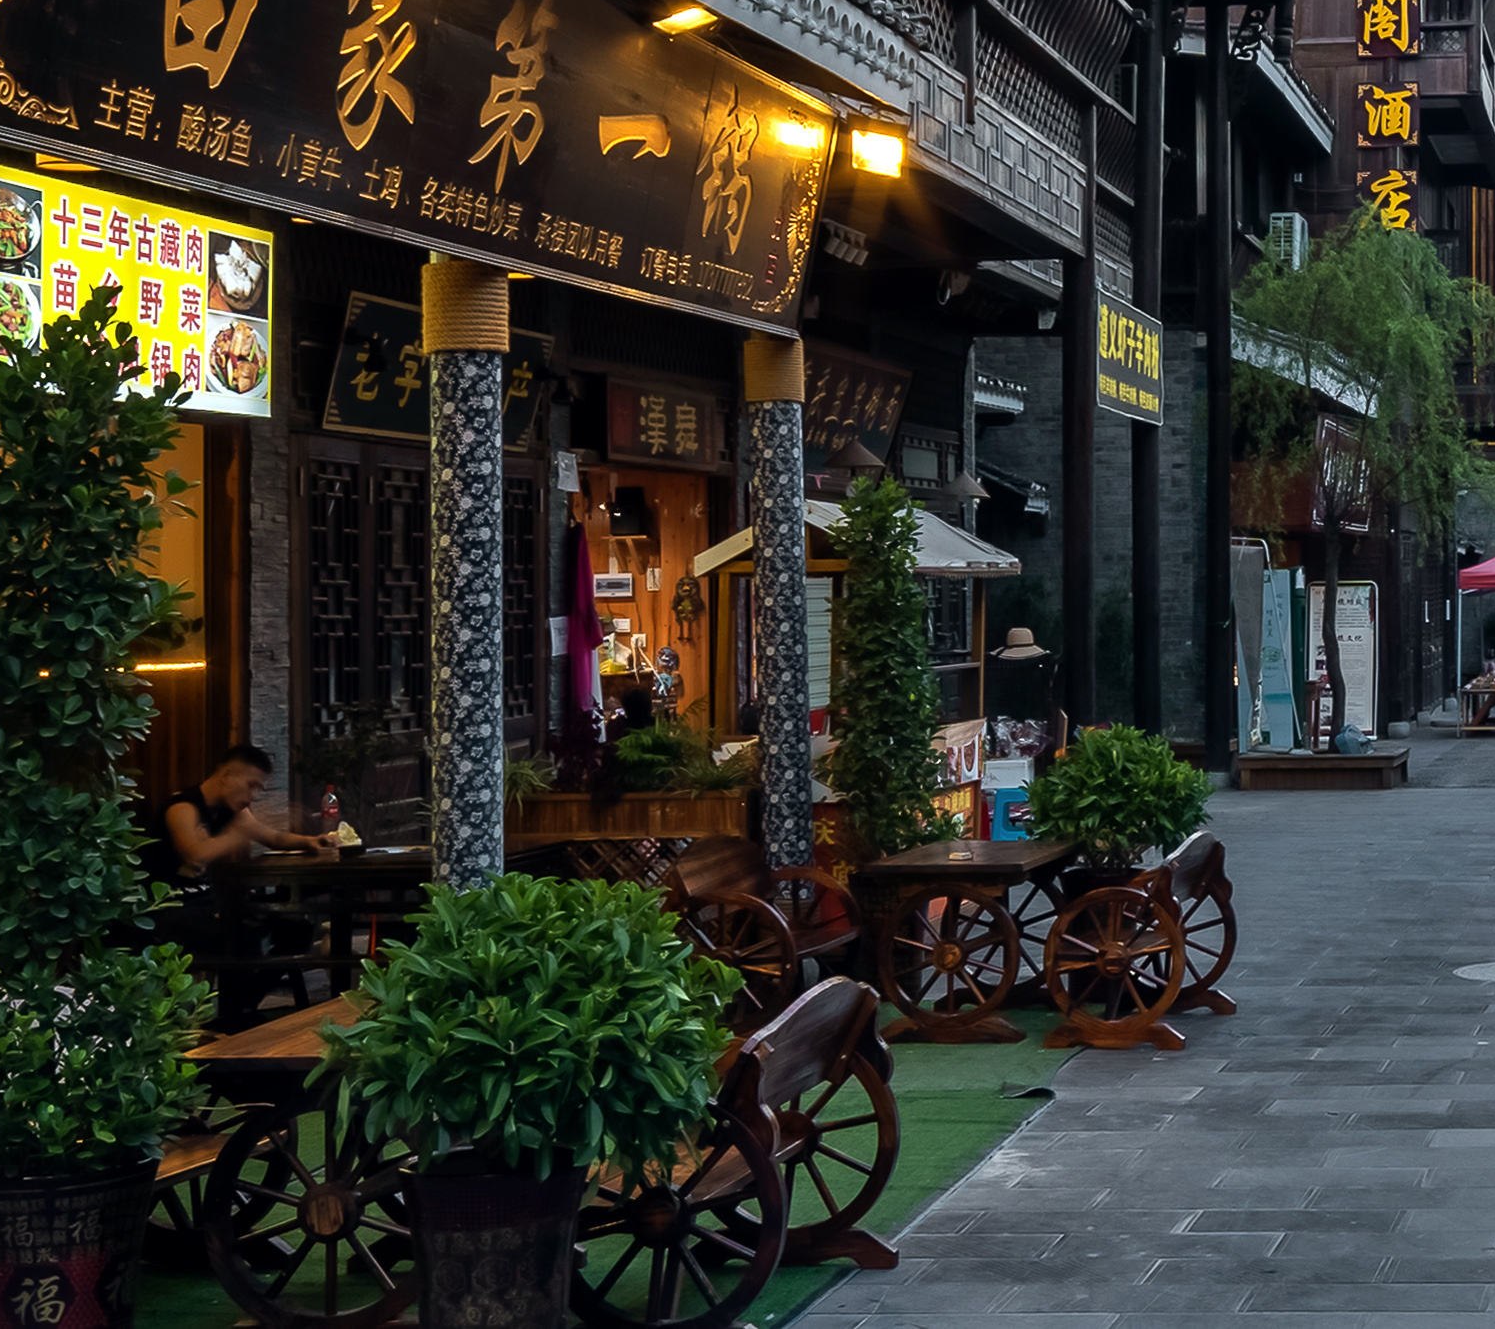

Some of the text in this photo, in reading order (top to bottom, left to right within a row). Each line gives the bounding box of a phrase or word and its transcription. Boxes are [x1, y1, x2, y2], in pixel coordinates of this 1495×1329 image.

[52, 196, 205, 273] 十三年古藏肉
[11, 1275, 65, 1326] 福
